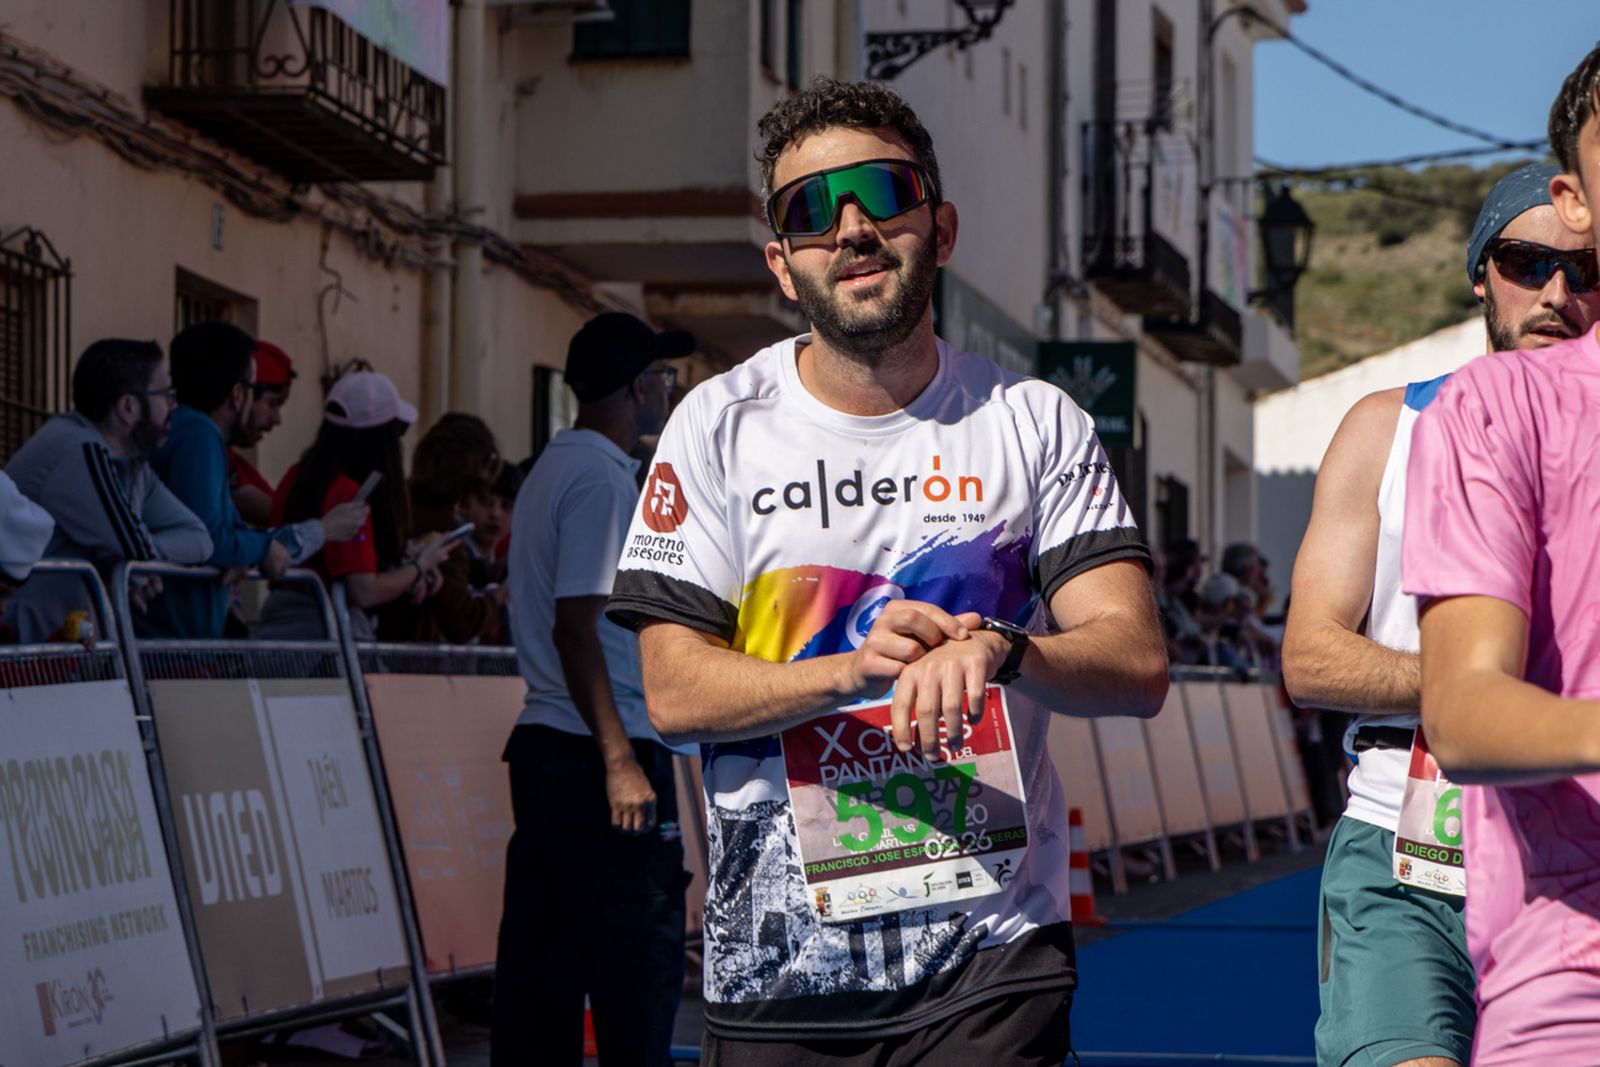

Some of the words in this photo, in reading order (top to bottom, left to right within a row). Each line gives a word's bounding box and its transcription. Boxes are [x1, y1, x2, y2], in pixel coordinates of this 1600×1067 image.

[752, 455, 984, 529] calderón
[923, 512, 957, 524] desde
[962, 511, 986, 524] 1949
[627, 546, 684, 566] asesores
[633, 534, 684, 553] moreno
[813, 721, 853, 763] X
[955, 746, 977, 760] DEL
[836, 762, 976, 852] 597
[0, 749, 153, 904] TECNOCASA
[182, 789, 283, 906] UNED
[806, 856, 870, 876] FRANCISCO
[873, 850, 902, 865] JOSE
[903, 842, 960, 861] ESPINOSA
[925, 835, 960, 860] 02
[1404, 842, 1450, 864] DIEGO
[321, 865, 380, 921] MARTOS
[22, 915, 110, 962] FRANCHISING
[109, 903, 170, 942] NETWORK
